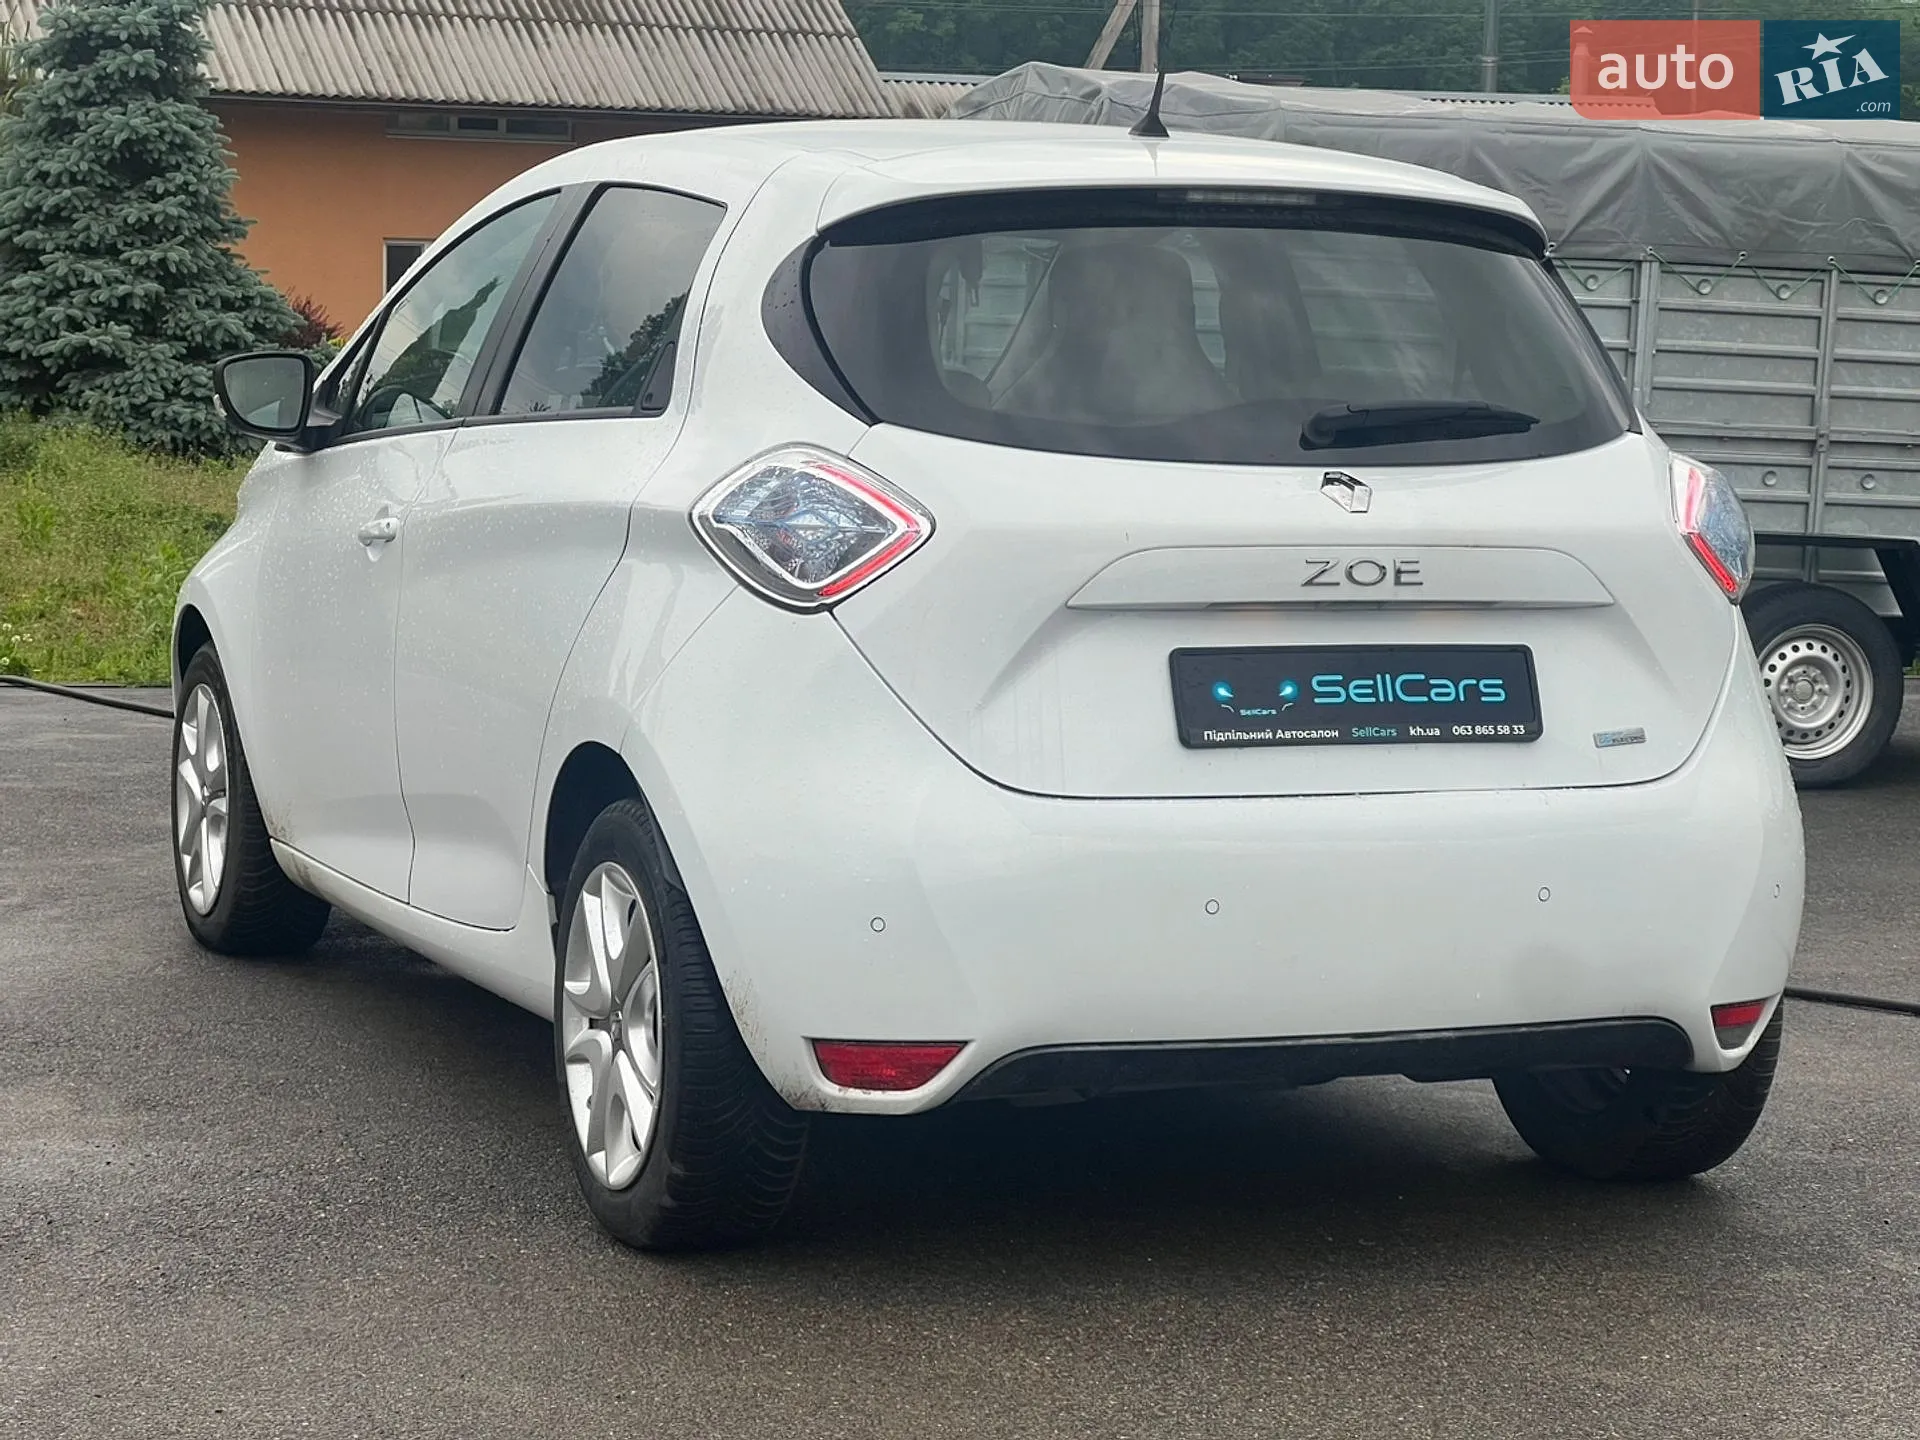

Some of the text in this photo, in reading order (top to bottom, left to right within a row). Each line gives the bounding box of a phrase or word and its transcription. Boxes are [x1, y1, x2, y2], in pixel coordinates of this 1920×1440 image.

[1301, 557, 1424, 587] ZOE
[1311, 673, 1506, 703] SellCars
[1203, 728, 1340, 742] Підпільний Автосалон
[1351, 724, 1526, 738] SellCars kh.ua 063 865 58 33
